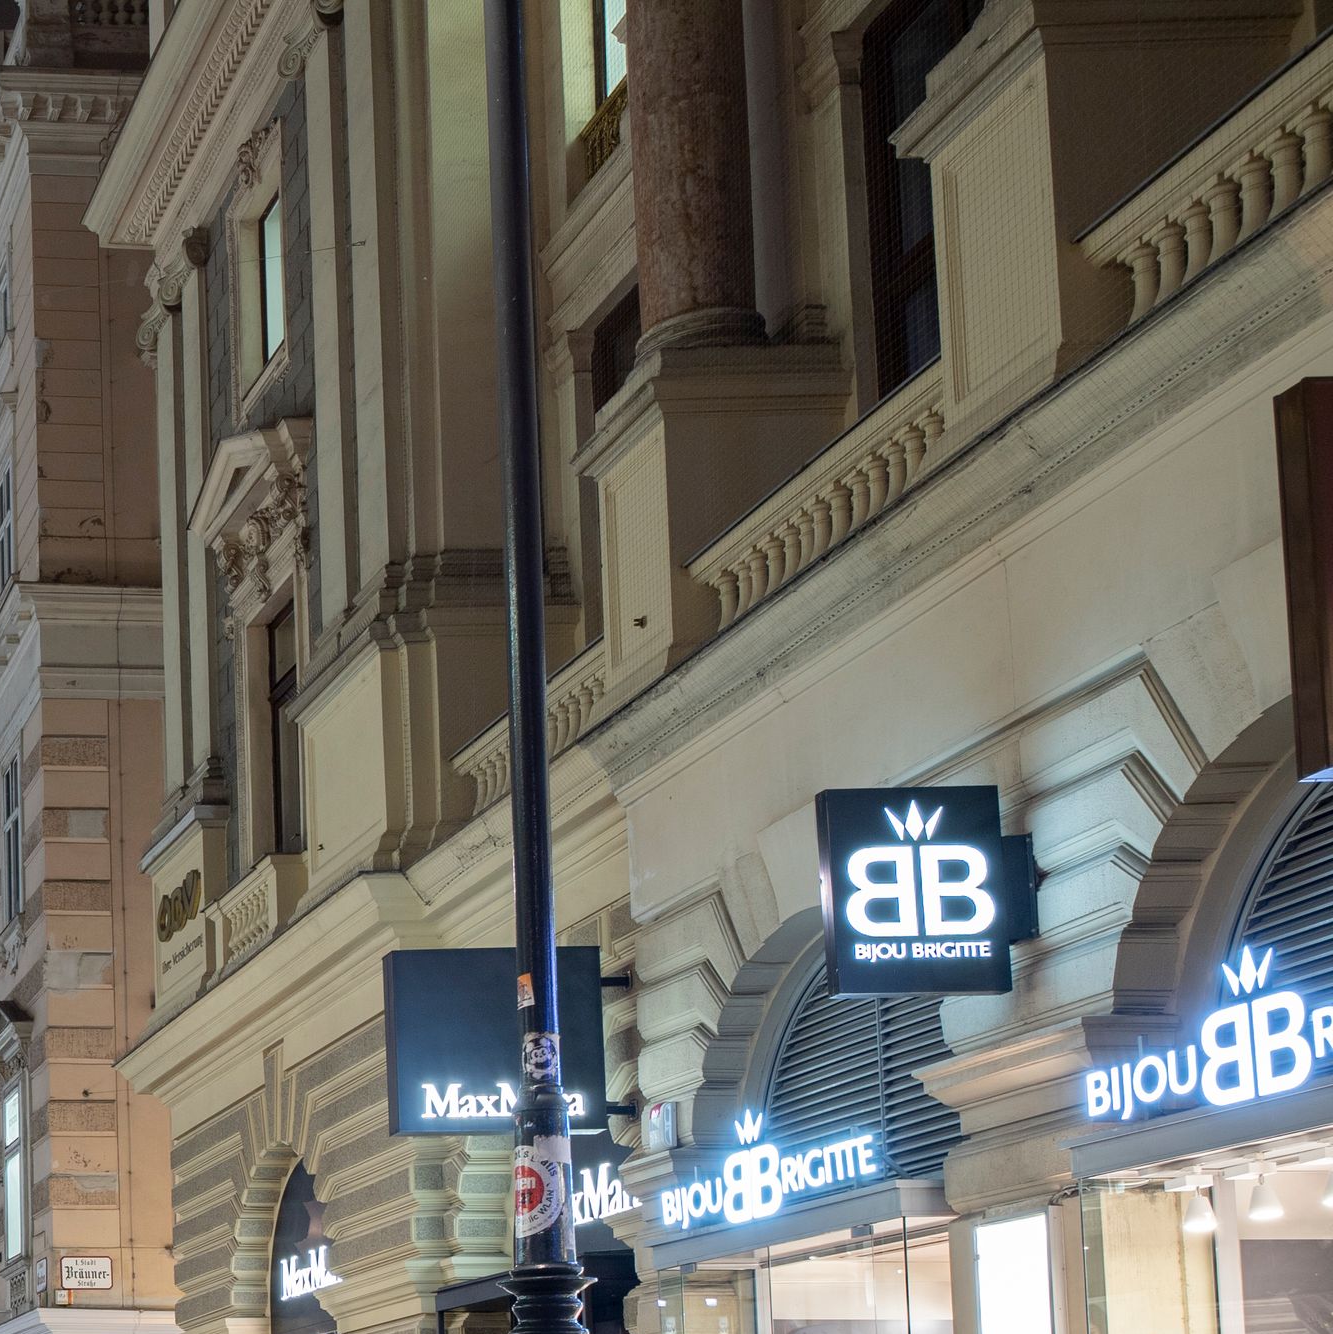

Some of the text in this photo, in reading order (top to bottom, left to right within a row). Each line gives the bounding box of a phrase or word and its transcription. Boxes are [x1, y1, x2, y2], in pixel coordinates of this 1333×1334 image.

[854, 940, 992, 963] BIJOU BRIGITTE
[1086, 1045, 1198, 1120] BIJOU
[661, 1177, 722, 1229] BIJOU
[64, 1266, 110, 1280] Bräuner-
